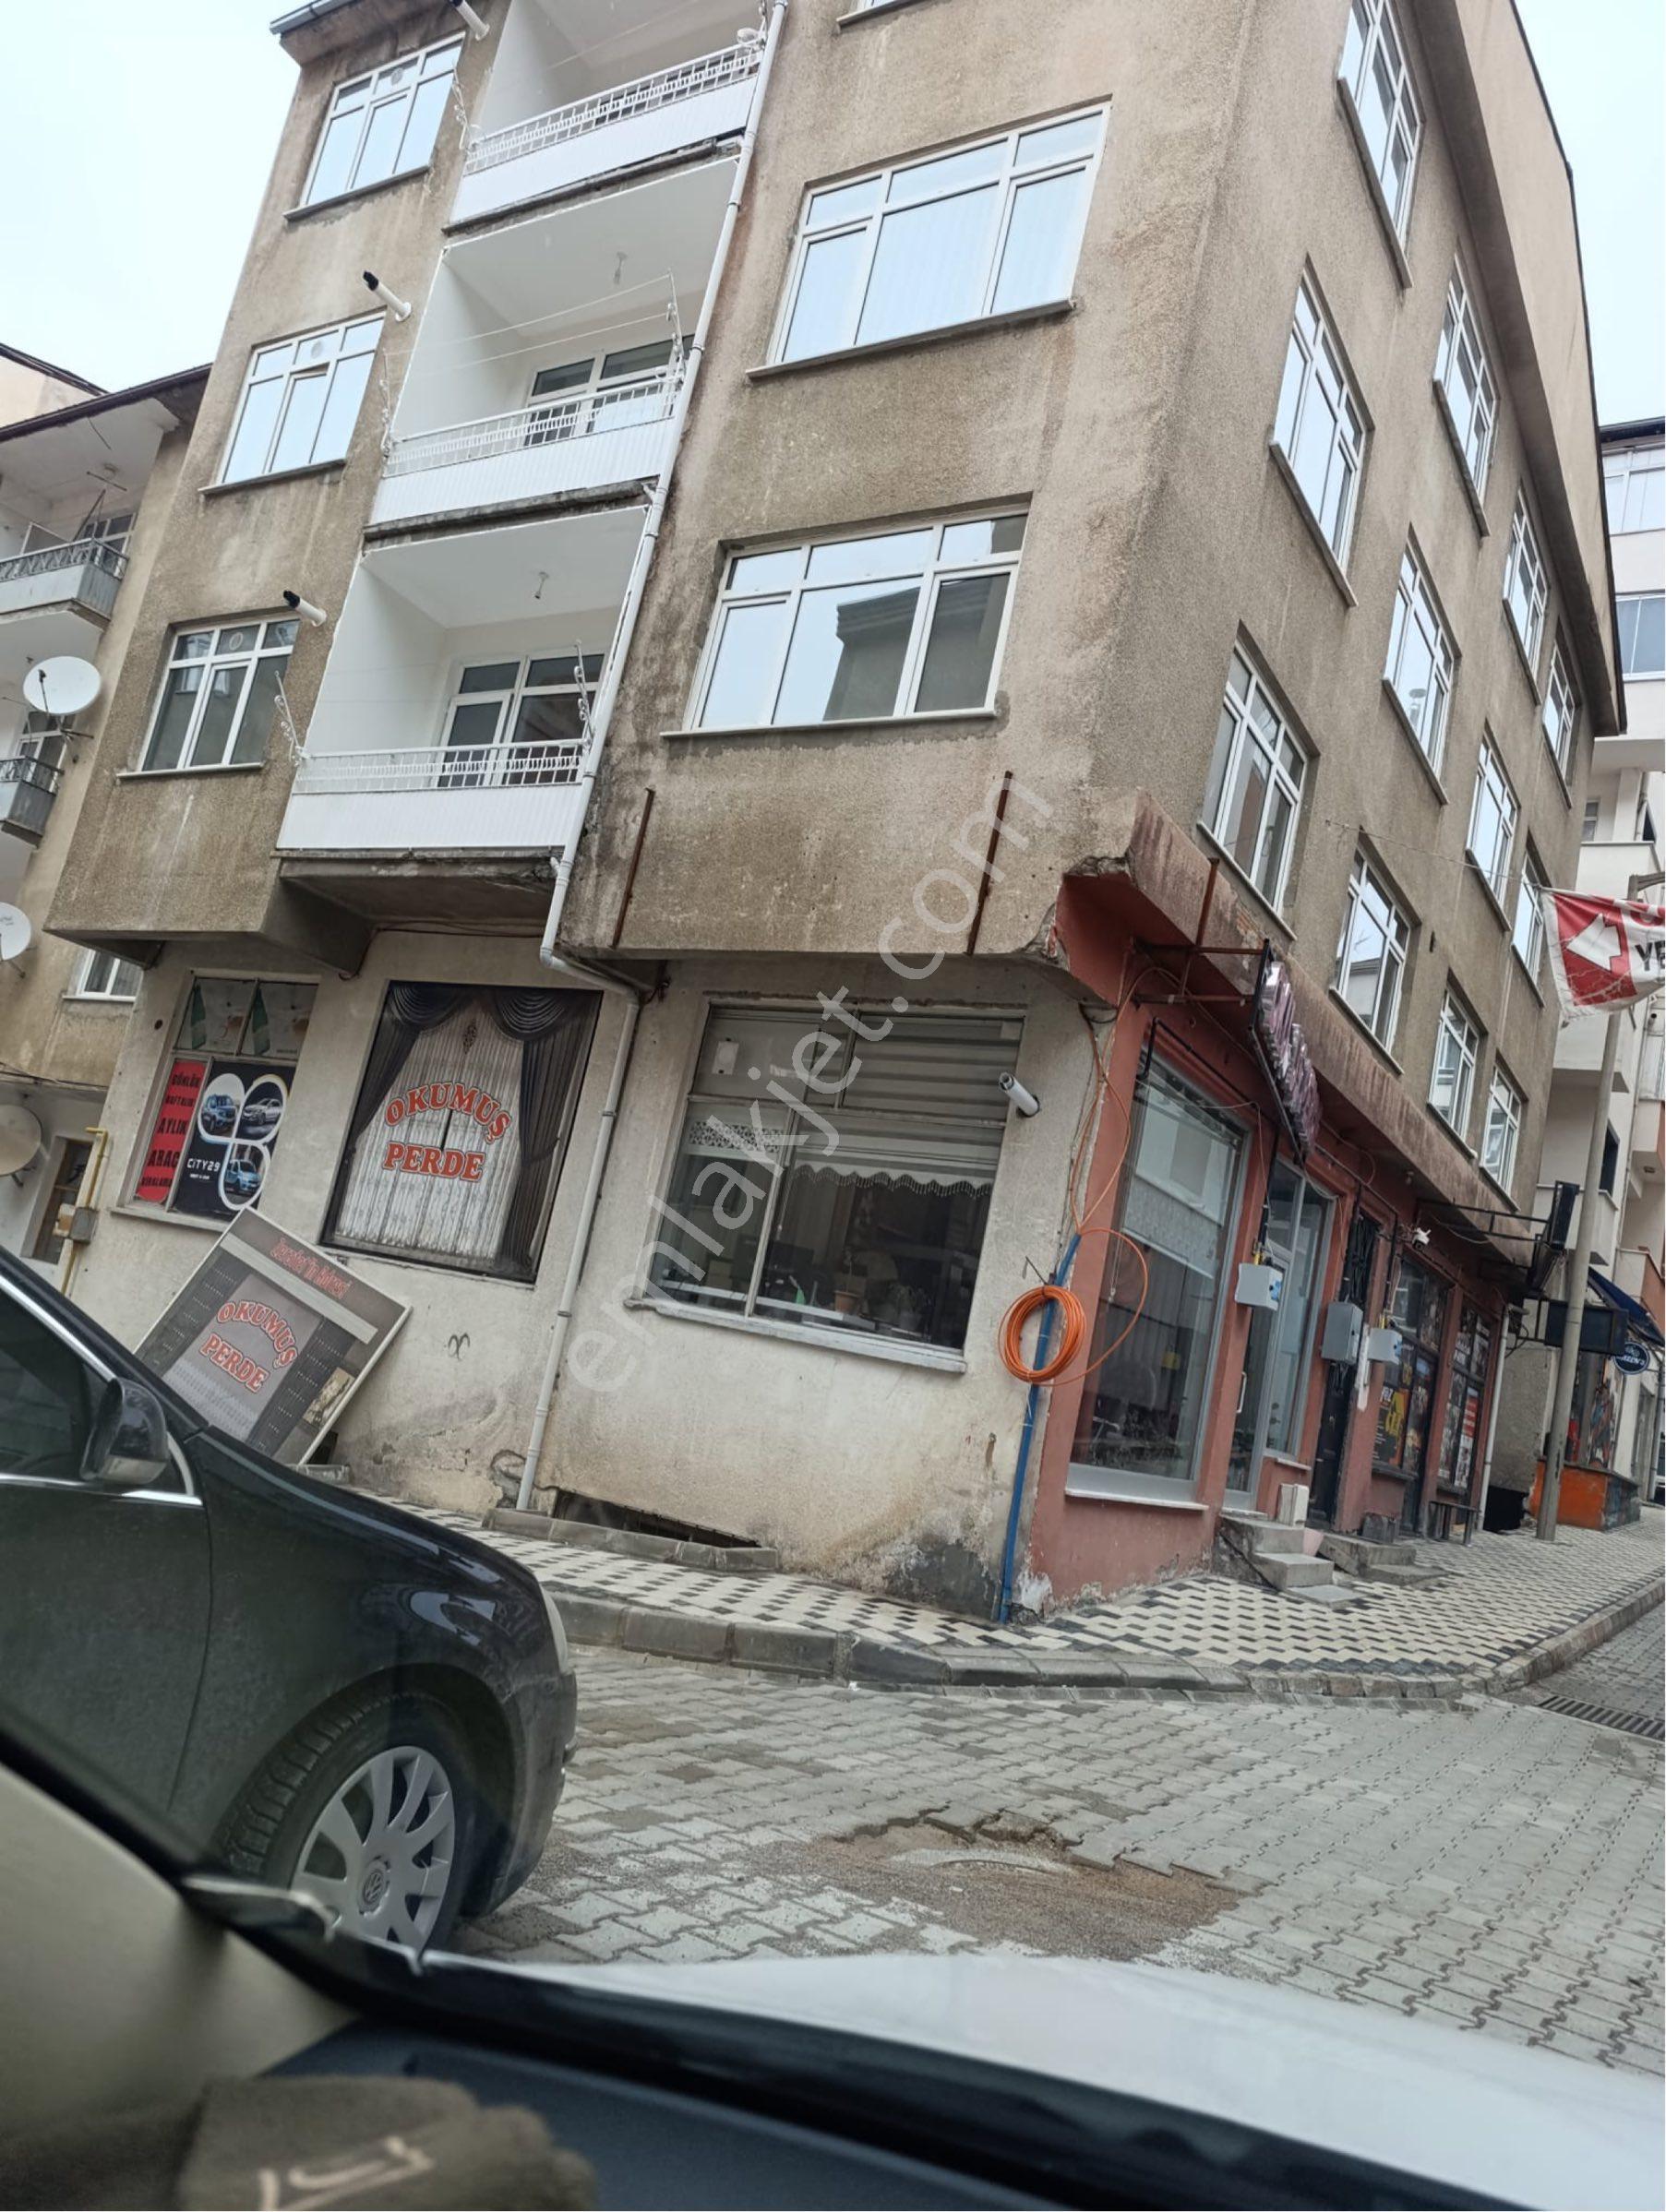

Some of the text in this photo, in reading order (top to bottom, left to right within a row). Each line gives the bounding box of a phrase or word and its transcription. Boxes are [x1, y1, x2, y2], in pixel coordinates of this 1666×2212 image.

[385, 1082, 511, 1144] OKUMUŞ
[382, 1141, 485, 1183] PERDE
[198, 1333, 271, 1394] PERDE
[216, 1299, 298, 1369] OKUMUŞ
